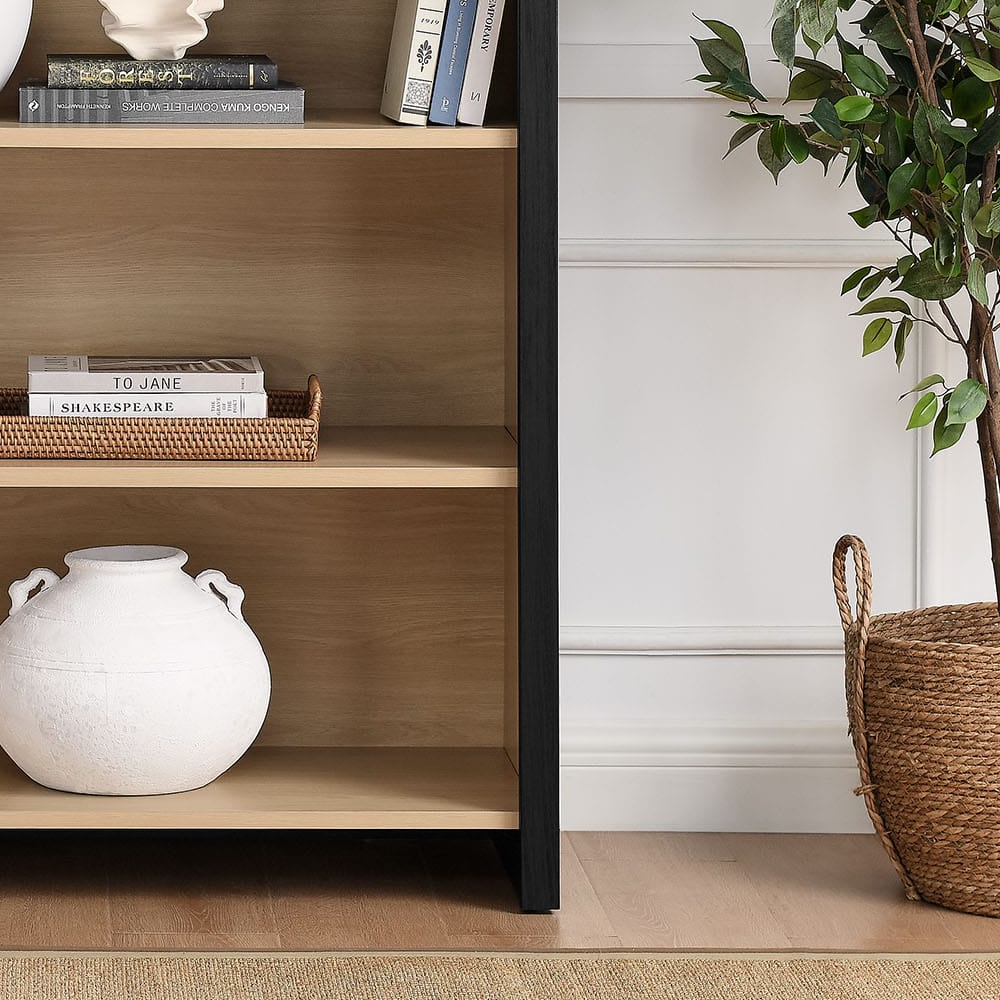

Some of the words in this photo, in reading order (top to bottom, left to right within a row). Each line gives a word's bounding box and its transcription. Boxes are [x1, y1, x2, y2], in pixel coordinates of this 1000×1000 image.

[421, 17, 439, 25] 1919
[80, 64, 193, 86] FOREST
[122, 102, 160, 112] WORKS
[163, 102, 219, 112] COMPLETE
[221, 103, 251, 112] KUMA
[254, 103, 290, 112] KENGO
[112, 377, 133, 390] TO
[139, 377, 182, 390] JANE
[60, 402, 174, 414] SHAKESPEARE
